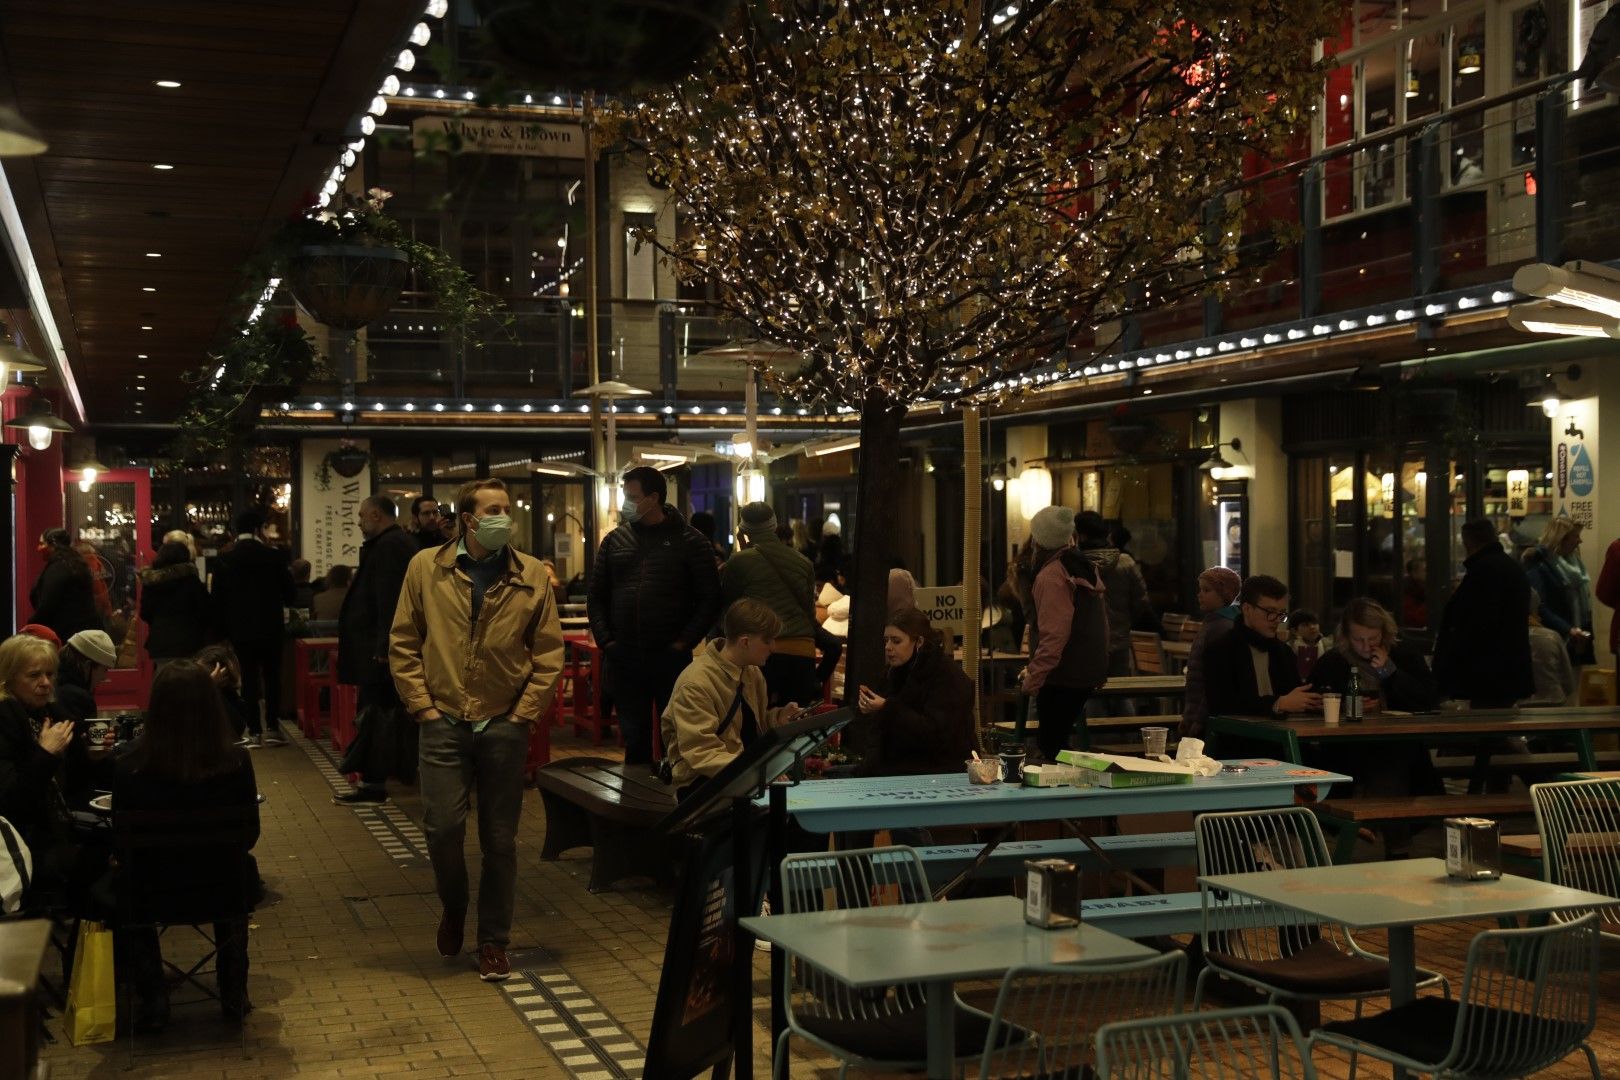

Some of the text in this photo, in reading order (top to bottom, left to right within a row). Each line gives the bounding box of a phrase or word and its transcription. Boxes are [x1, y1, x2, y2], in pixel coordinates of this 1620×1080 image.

[500, 125, 513, 139] &
[1571, 501, 1592, 511] FREE
[335, 481, 360, 556] Whyte &
[936, 595, 956, 607] NO
